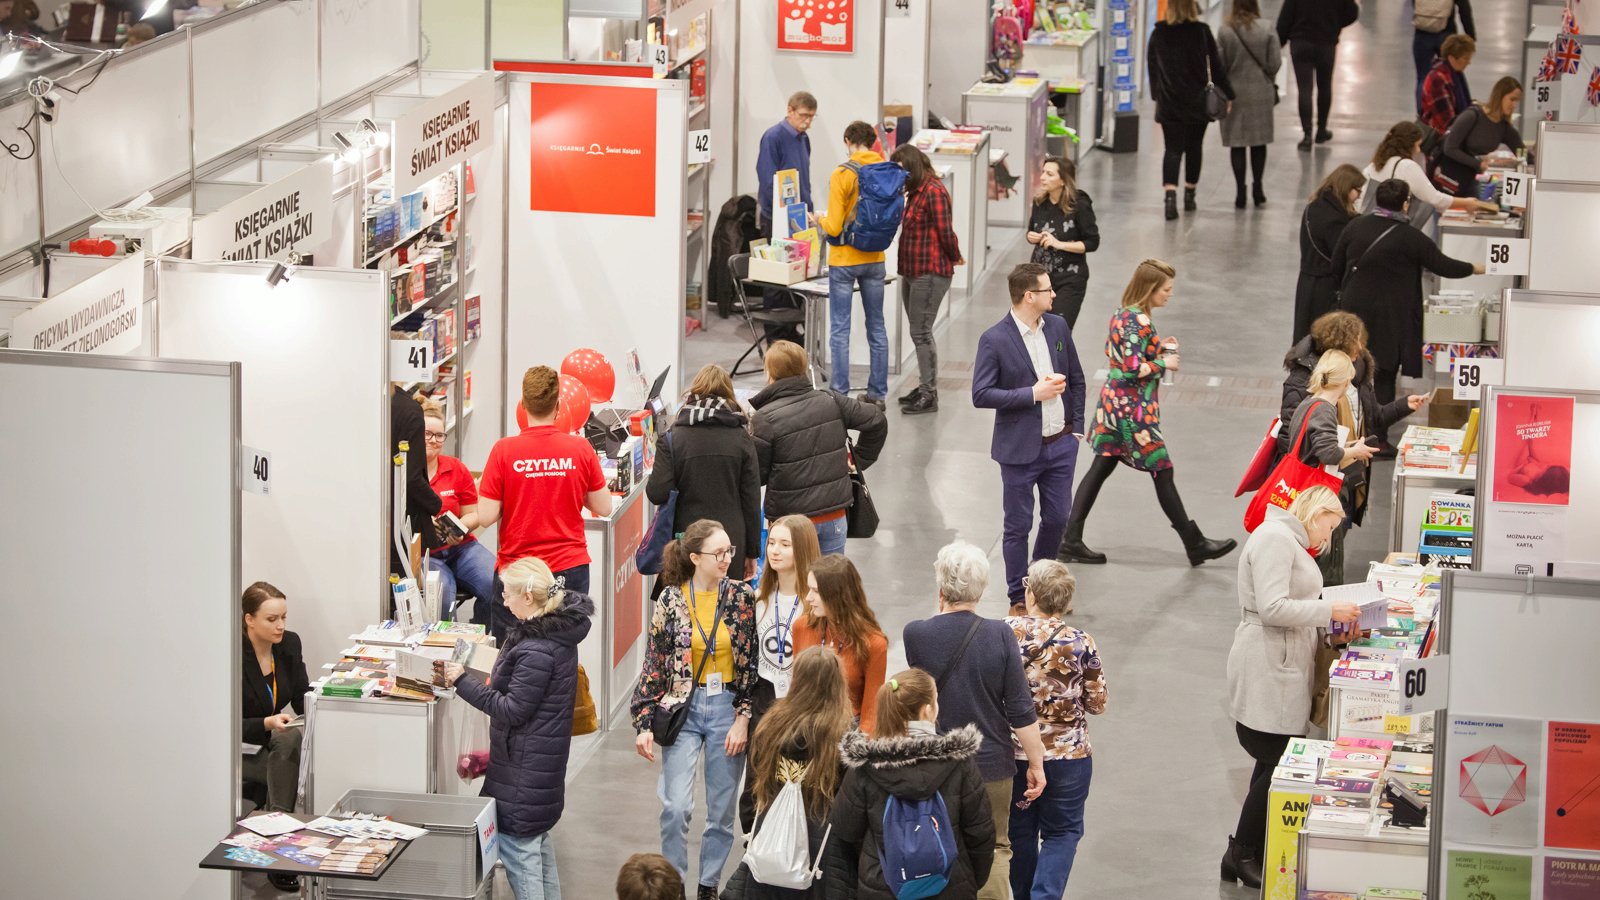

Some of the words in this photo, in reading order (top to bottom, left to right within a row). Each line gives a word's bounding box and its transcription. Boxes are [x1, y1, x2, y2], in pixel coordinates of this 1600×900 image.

[655, 49, 666, 65] 43
[1537, 86, 1550, 103] 56
[422, 100, 470, 141] KSIĘGARNIE
[411, 148, 443, 176] ŚWIAT
[445, 119, 480, 158] KSIĄŻKI
[695, 134, 709, 153] 42
[1505, 176, 1521, 196] 57
[234, 190, 300, 243] KSIĘGARNIE
[264, 211, 313, 259] KSIĄŻKI
[1490, 244, 1510, 264] 58
[33, 318, 69, 350] OFICYNA
[71, 287, 126, 334] WYDAWNICZA
[79, 306, 137, 353] ZIELONOGÓRSKI
[408, 346, 427, 369] 41
[1458, 365, 1480, 387] 59
[1521, 432, 1548, 440] TINDERA
[1526, 425, 1552, 434] TWARZY
[253, 455, 269, 482] 40
[513, 457, 577, 473] CZYTAM.
[1436, 500, 1472, 509] OWANKA
[616, 544, 640, 593] CZYTA
[1405, 667, 1427, 699] 60
[1454, 720, 1484, 728] STRAŻNICY
[1551, 861, 1577, 870] PIOTR
